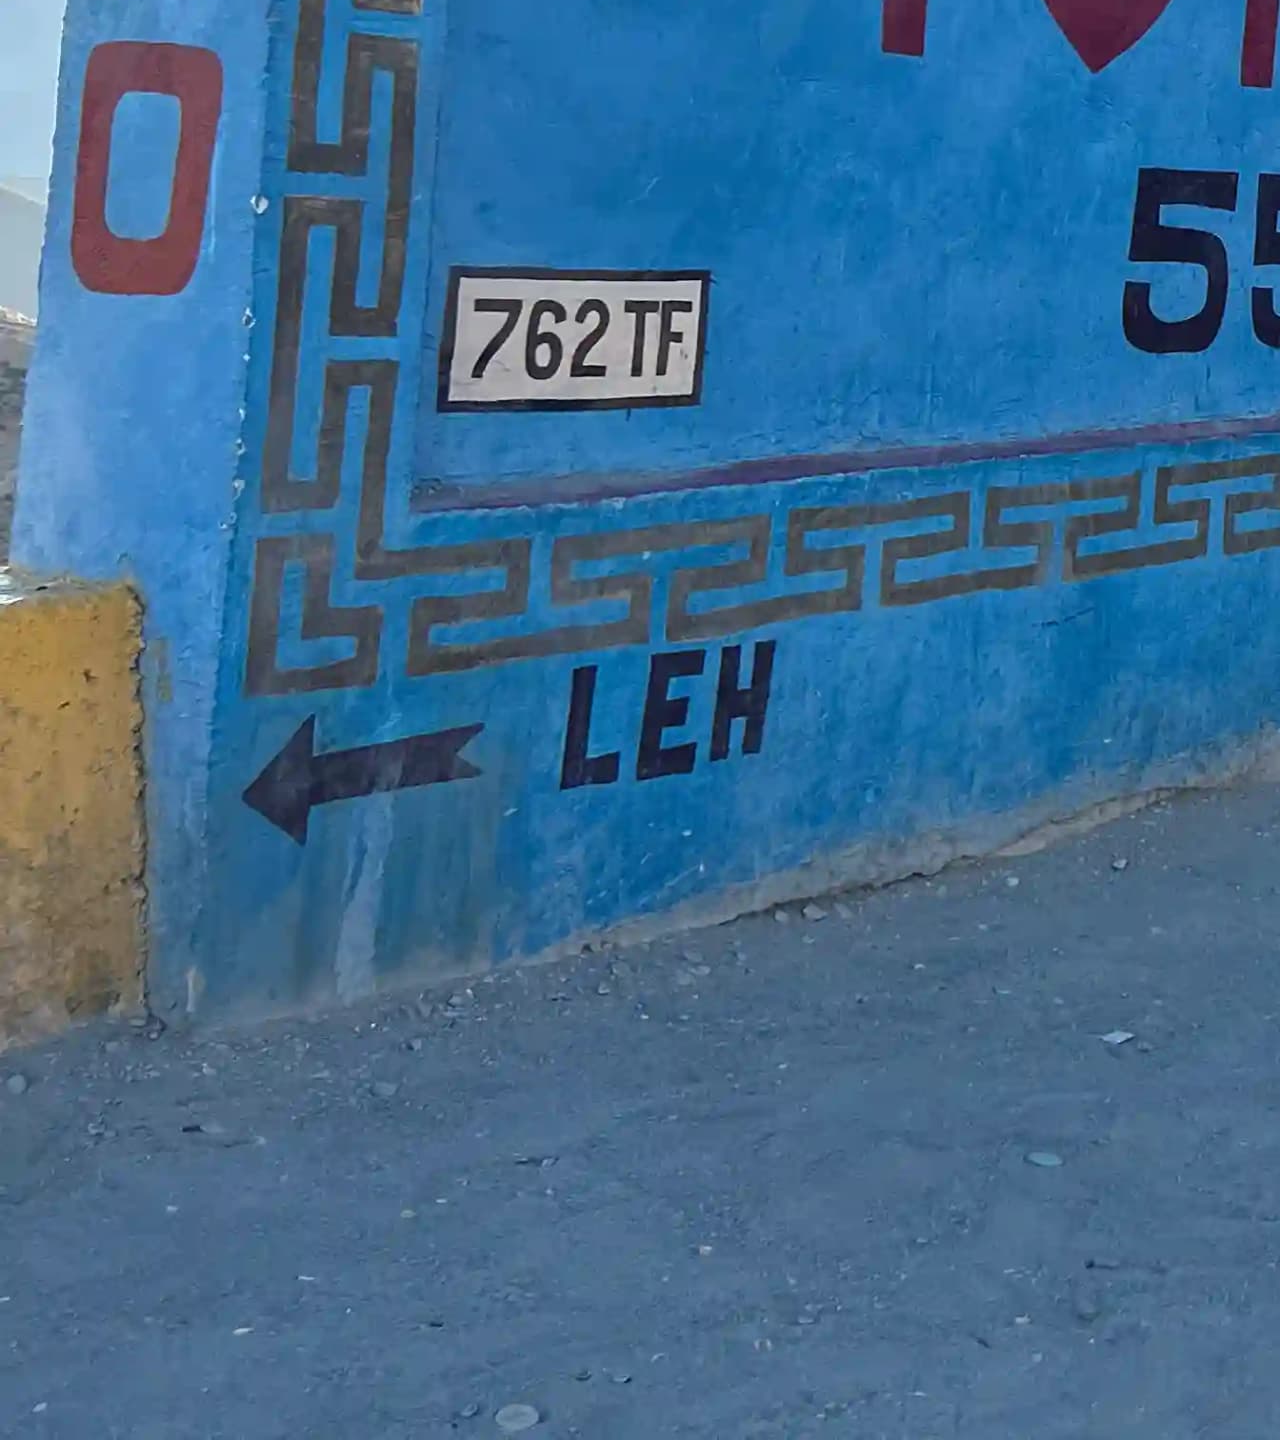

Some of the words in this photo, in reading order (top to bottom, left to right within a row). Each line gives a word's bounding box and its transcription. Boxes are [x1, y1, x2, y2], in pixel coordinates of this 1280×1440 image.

[470, 297, 611, 380] 762
[626, 299, 694, 377] TF
[559, 639, 777, 791] LEH
